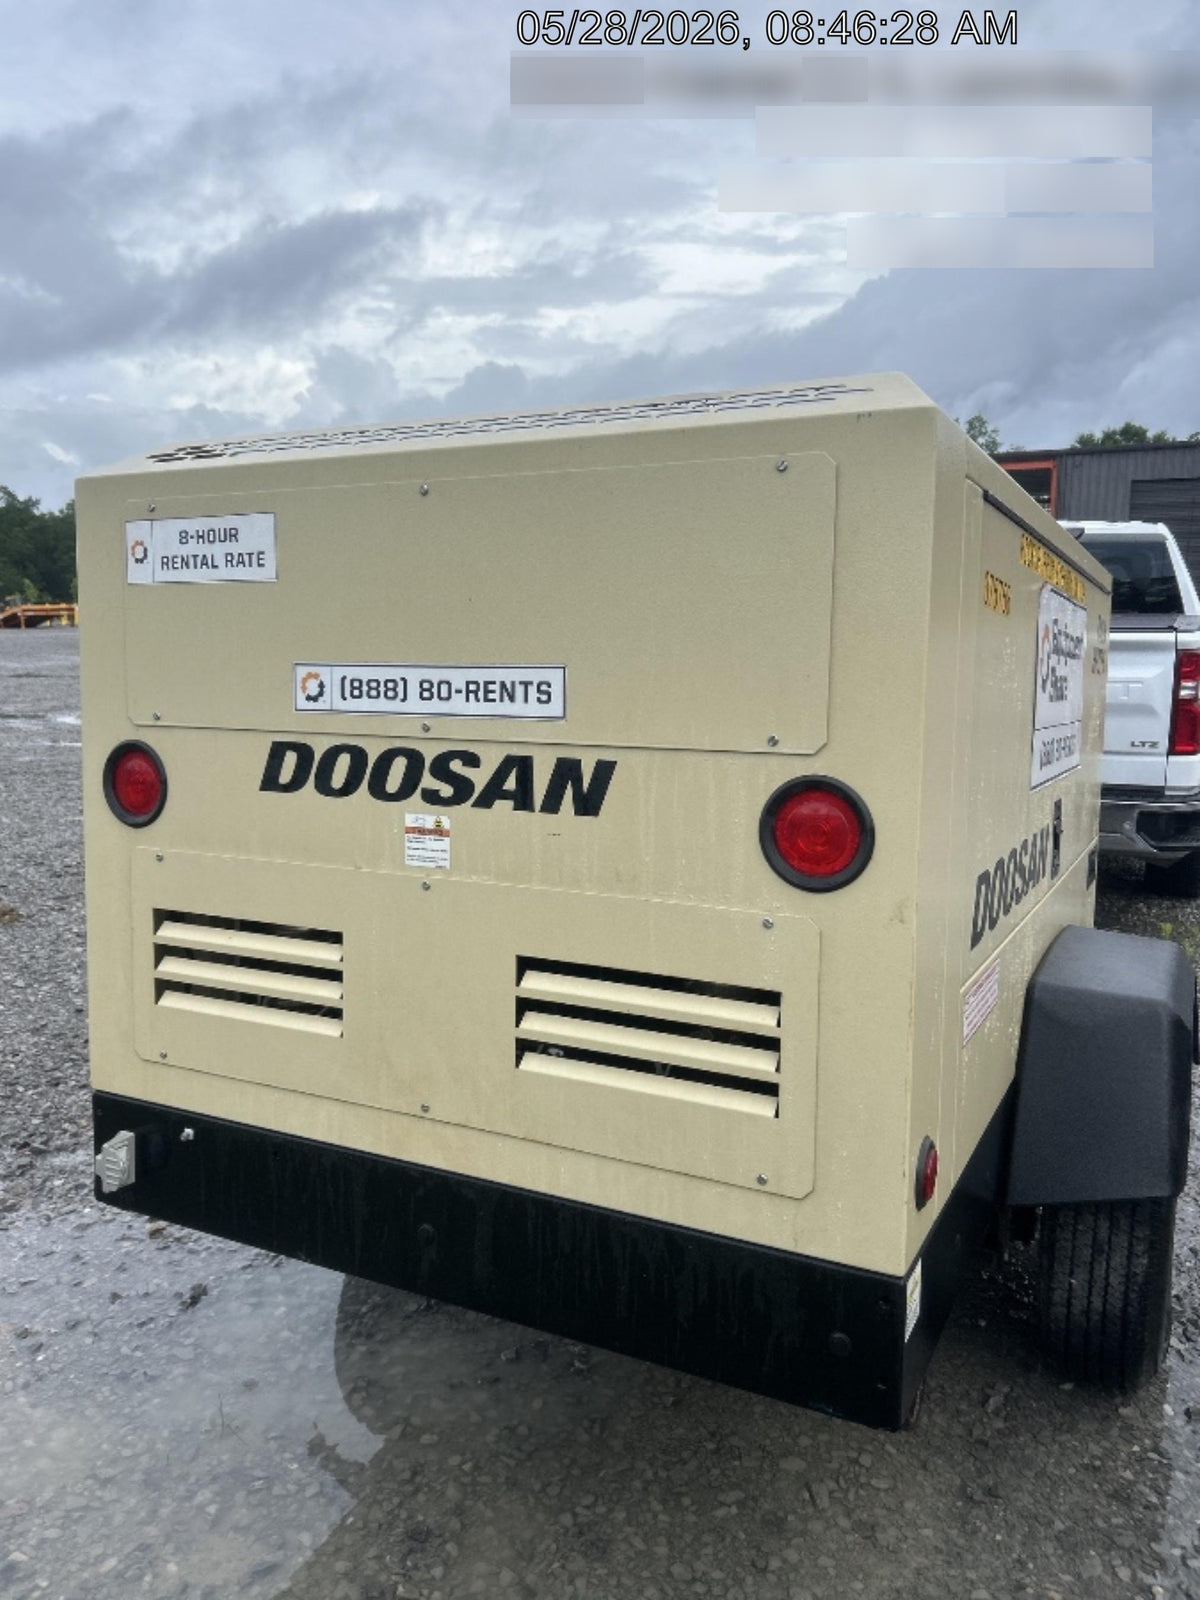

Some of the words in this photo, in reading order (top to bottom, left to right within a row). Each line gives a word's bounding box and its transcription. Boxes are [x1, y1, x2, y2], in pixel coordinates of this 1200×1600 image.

[178, 527, 239, 545] 8-HOUR
[161, 553, 219, 571] RENTAL
[225, 551, 266, 568] RATE
[340, 675, 408, 702] (888)
[418, 679, 552, 705] 80-RENTS
[1130, 740, 1160, 749] LTZ
[259, 740, 618, 817] DOOSAN
[970, 822, 1050, 950] DOOSAN
